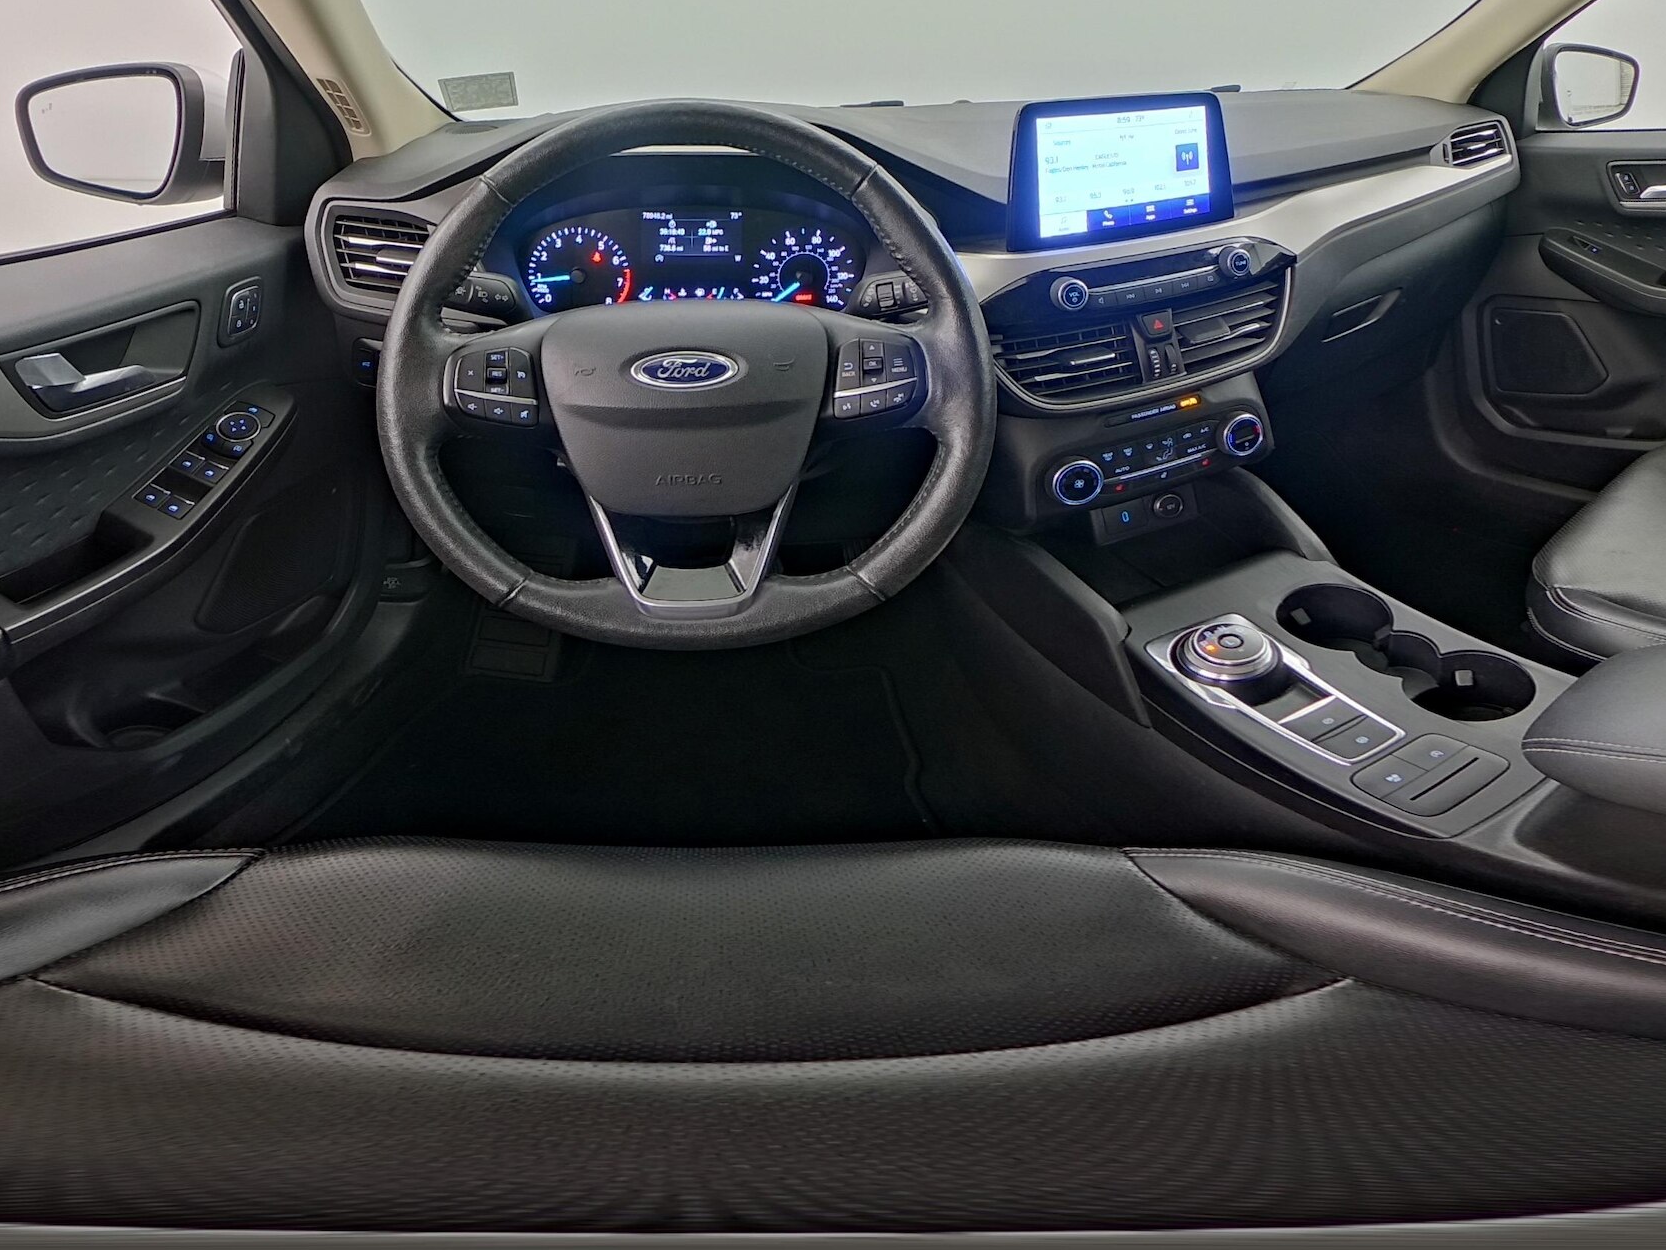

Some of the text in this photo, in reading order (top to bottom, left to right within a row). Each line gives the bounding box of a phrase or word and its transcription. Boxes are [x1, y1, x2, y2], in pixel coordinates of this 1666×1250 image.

[555, 238, 562, 248] 3
[575, 234, 583, 244] 4
[811, 236, 822, 244] 80
[598, 241, 604, 250] 5
[540, 251, 547, 261] 2
[765, 252, 776, 260] 40
[828, 249, 841, 257] 100
[612, 256, 619, 265] 6
[759, 276, 769, 284] 20
[837, 272, 848, 280] 120
[616, 277, 623, 287] 7
[545, 294, 552, 303] 0
[826, 295, 838, 303] 140
[657, 358, 710, 378] Ford
[1131, 408, 1159, 419] PASSENGER
[1115, 465, 1130, 473] AUTO
[654, 473, 722, 486] AIRBAG
